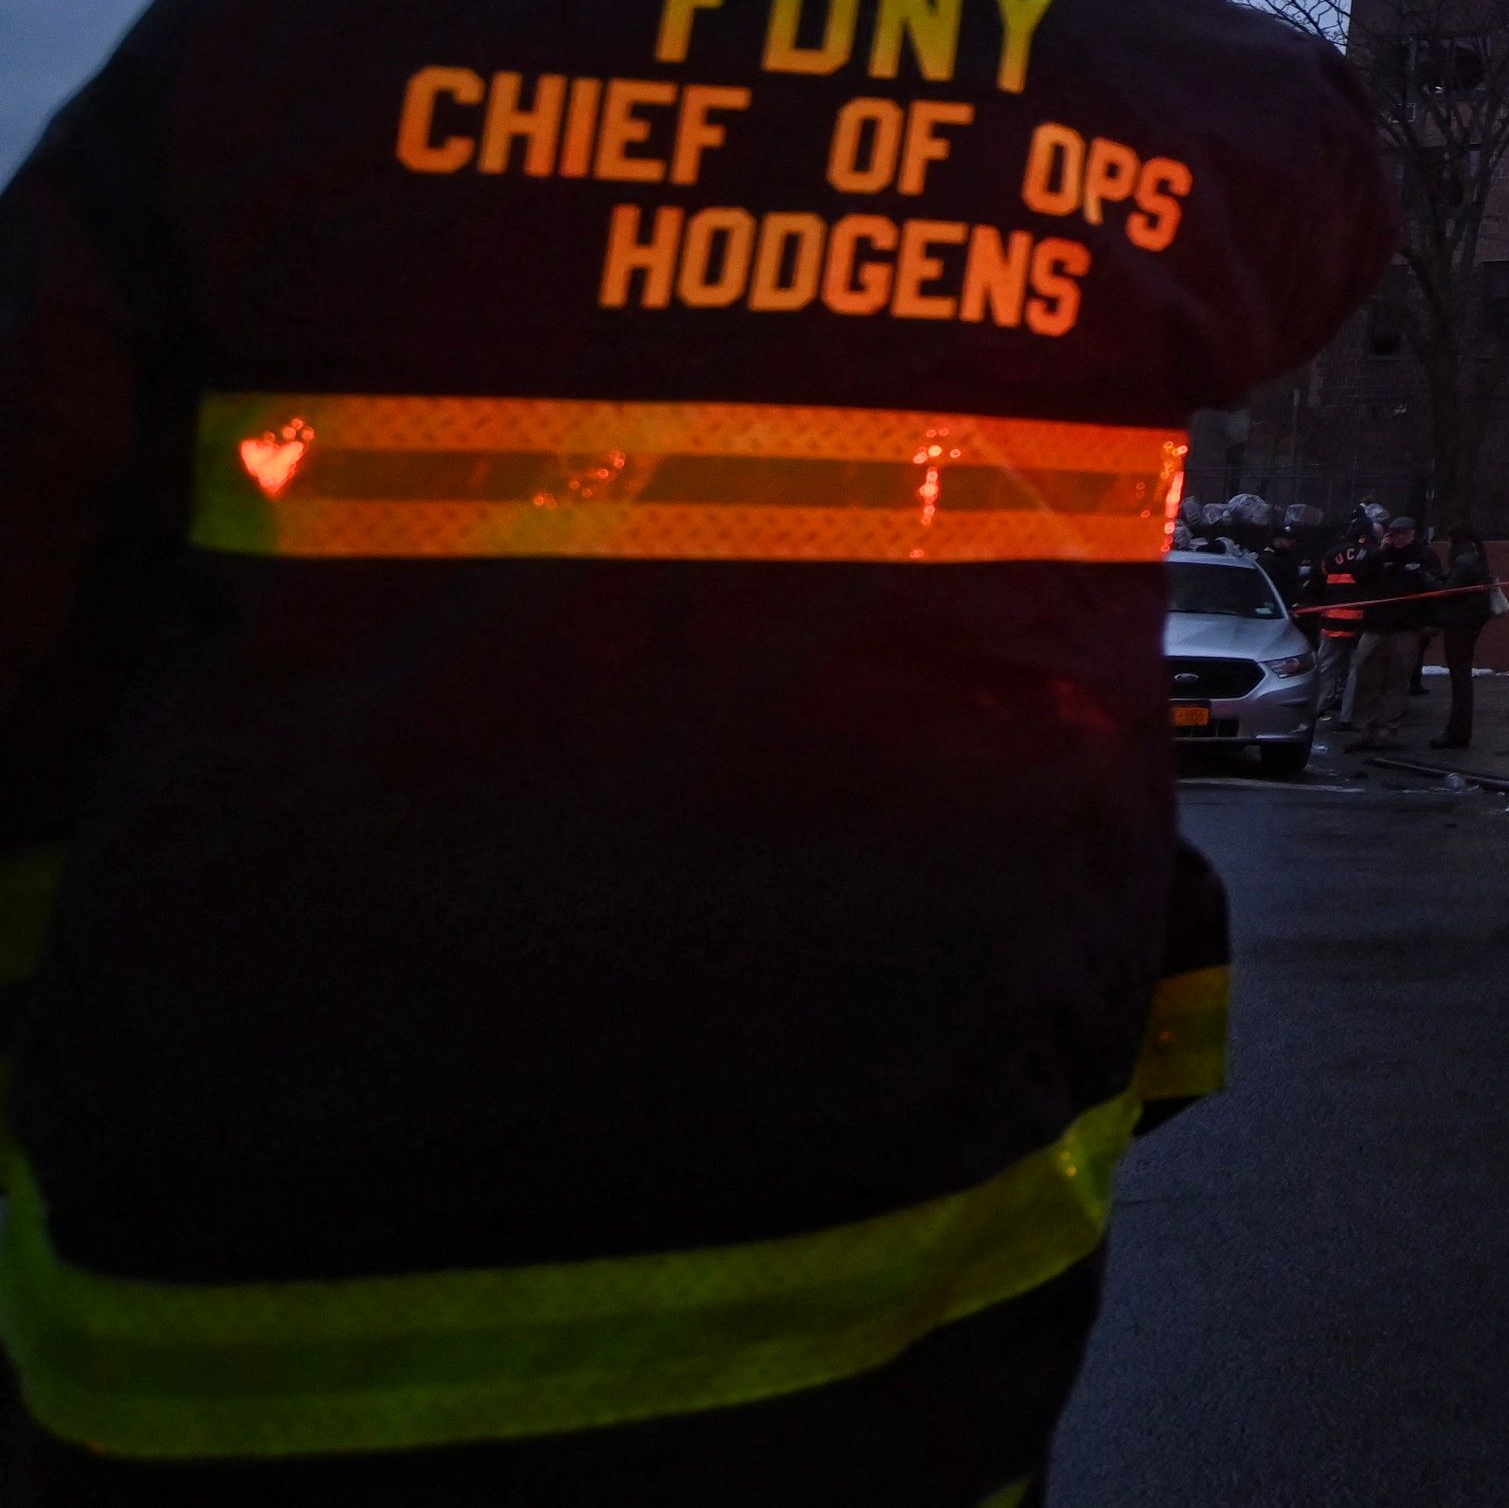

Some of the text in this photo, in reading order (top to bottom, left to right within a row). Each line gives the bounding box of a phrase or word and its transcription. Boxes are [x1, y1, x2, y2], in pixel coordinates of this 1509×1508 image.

[395, 65, 1193, 252] CHIEF OF OPS
[601, 203, 1092, 336] HODGENS
